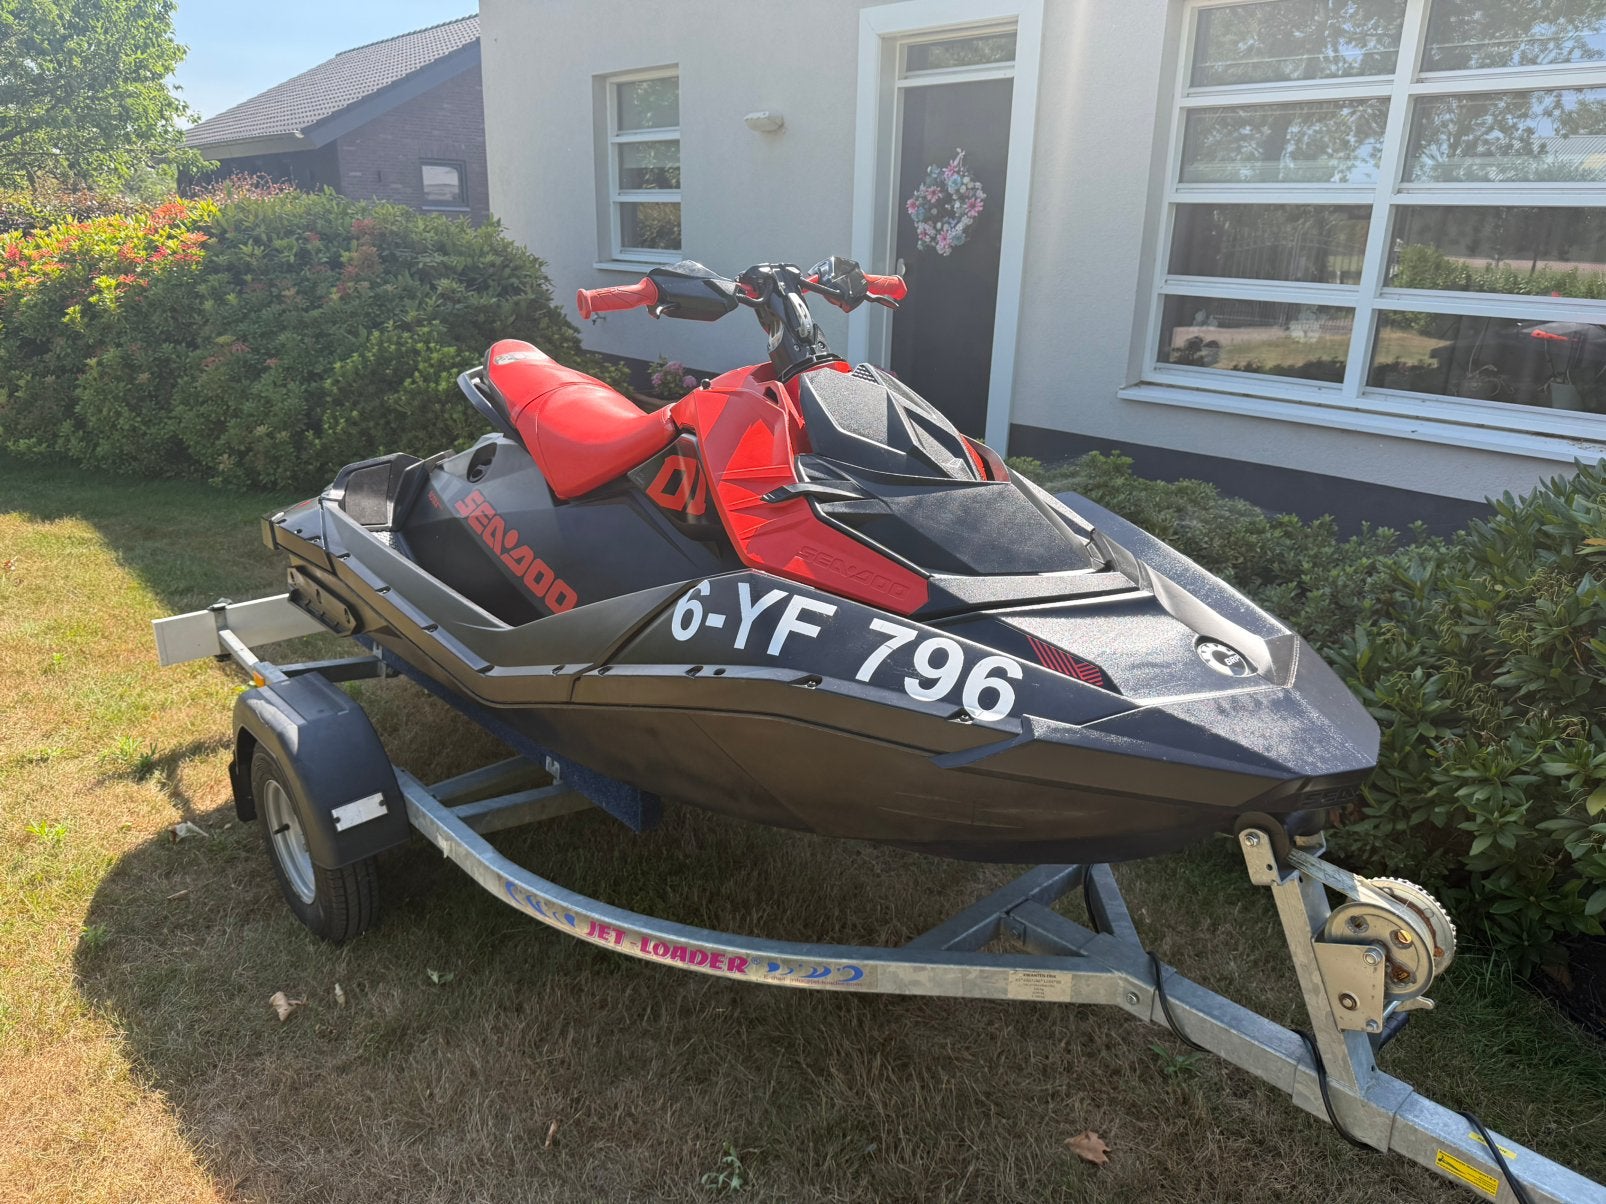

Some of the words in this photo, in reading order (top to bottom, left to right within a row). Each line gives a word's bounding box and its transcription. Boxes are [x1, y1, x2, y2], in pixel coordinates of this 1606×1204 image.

[671, 580, 838, 656] 6-YF
[855, 618, 1023, 722] 796
[1224, 654, 1241, 666] BRP
